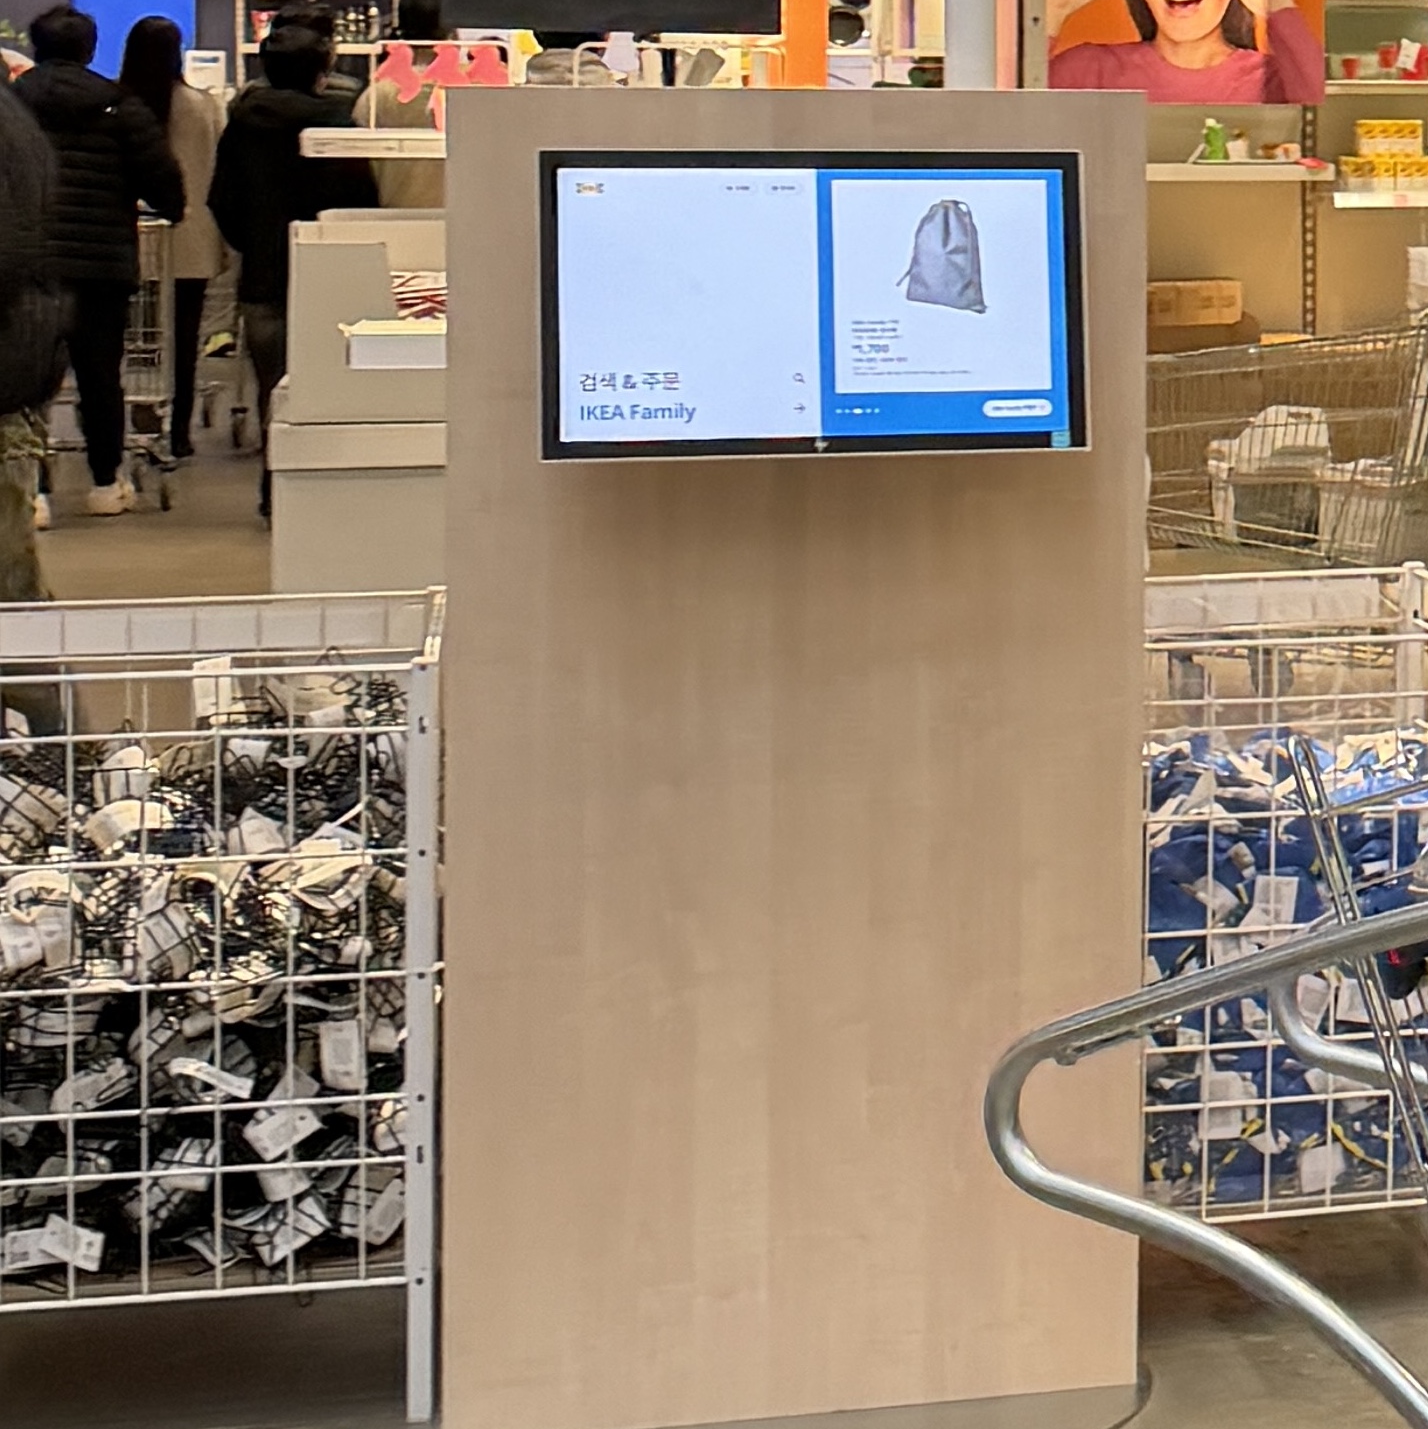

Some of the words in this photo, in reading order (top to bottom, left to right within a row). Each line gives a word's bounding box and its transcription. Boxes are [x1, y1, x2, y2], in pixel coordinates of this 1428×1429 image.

[579, 371, 617, 394] 검색
[641, 370, 681, 392] 주문
[579, 404, 626, 422] IKEA
[629, 401, 697, 425] Family
